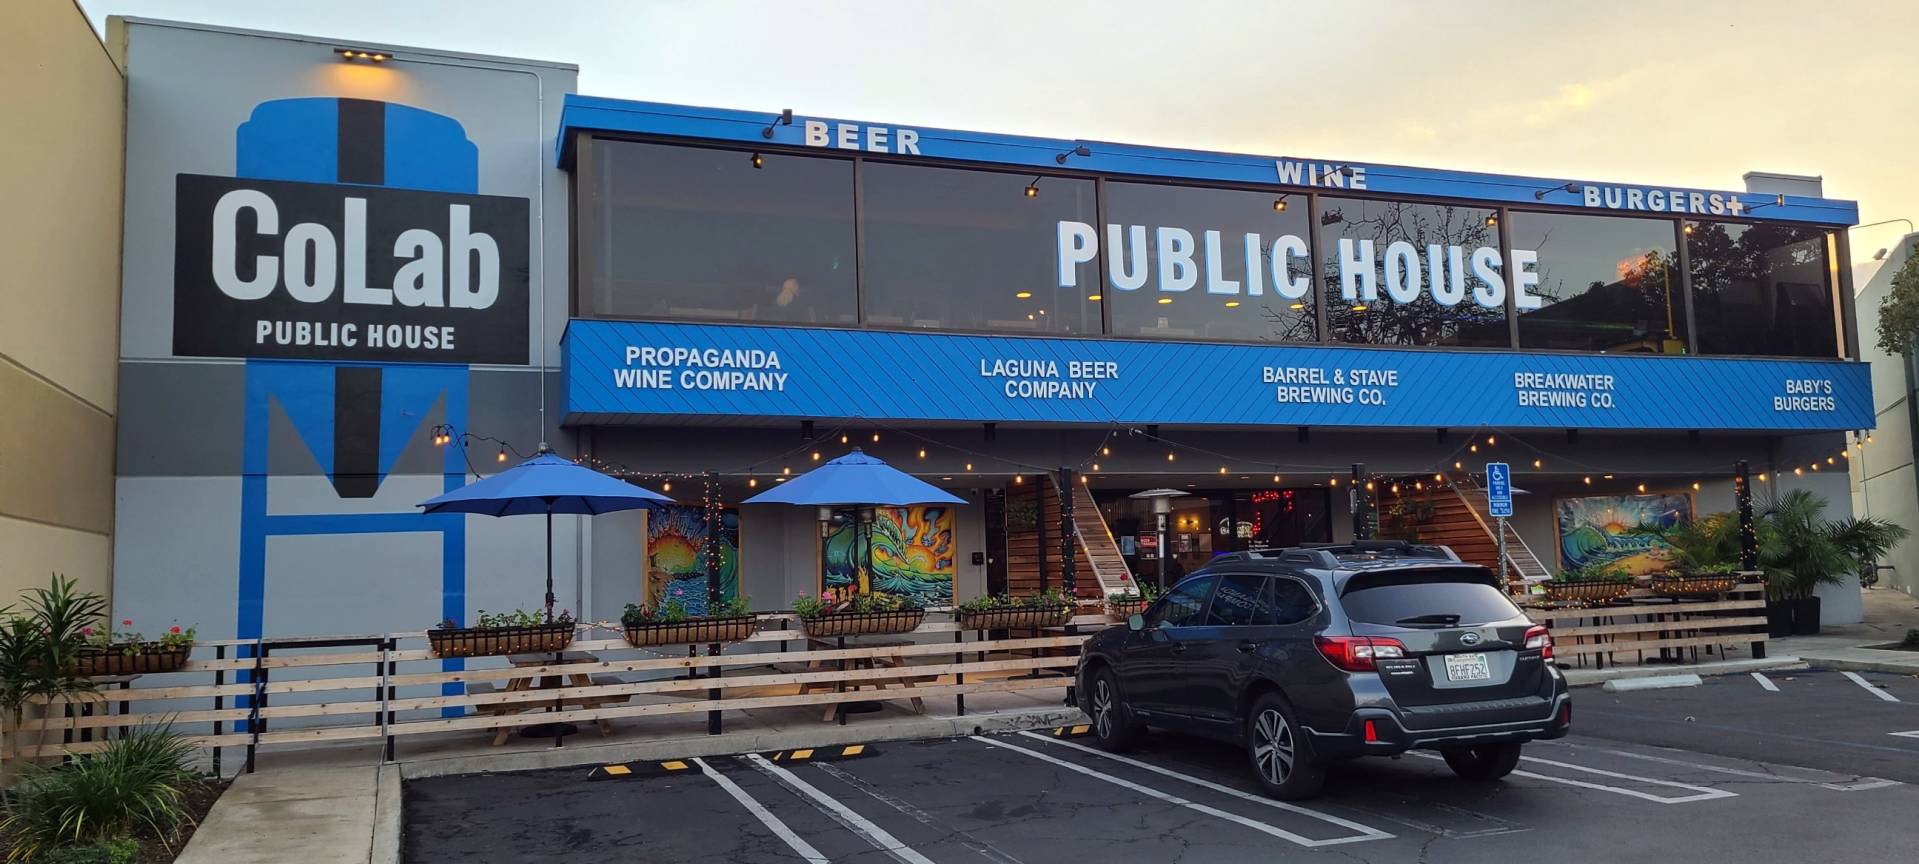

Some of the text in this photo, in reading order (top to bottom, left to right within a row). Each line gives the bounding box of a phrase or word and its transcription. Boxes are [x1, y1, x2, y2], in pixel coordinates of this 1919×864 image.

[805, 120, 921, 155] BEER
[1276, 160, 1367, 190] WINE
[212, 189, 500, 310] CoLab
[1057, 220, 1543, 309] PUBLIC HOUSE
[256, 320, 455, 350] PUBLIC HOUSE
[625, 346, 781, 369] PROPAGANDA
[981, 359, 1119, 379] LAGUNA BEER
[1263, 367, 1398, 386] BARREL & STAVE
[613, 369, 788, 392] WINE COMPANY
[1005, 380, 1097, 399] COMPANY
[1514, 373, 1614, 391] BREAKWATER
[1786, 379, 1832, 394] BABY'S
[1277, 386, 1386, 405] BREWING CO.
[1518, 391, 1615, 408] BREWING CO.
[1774, 396, 1835, 411] BURGERS
